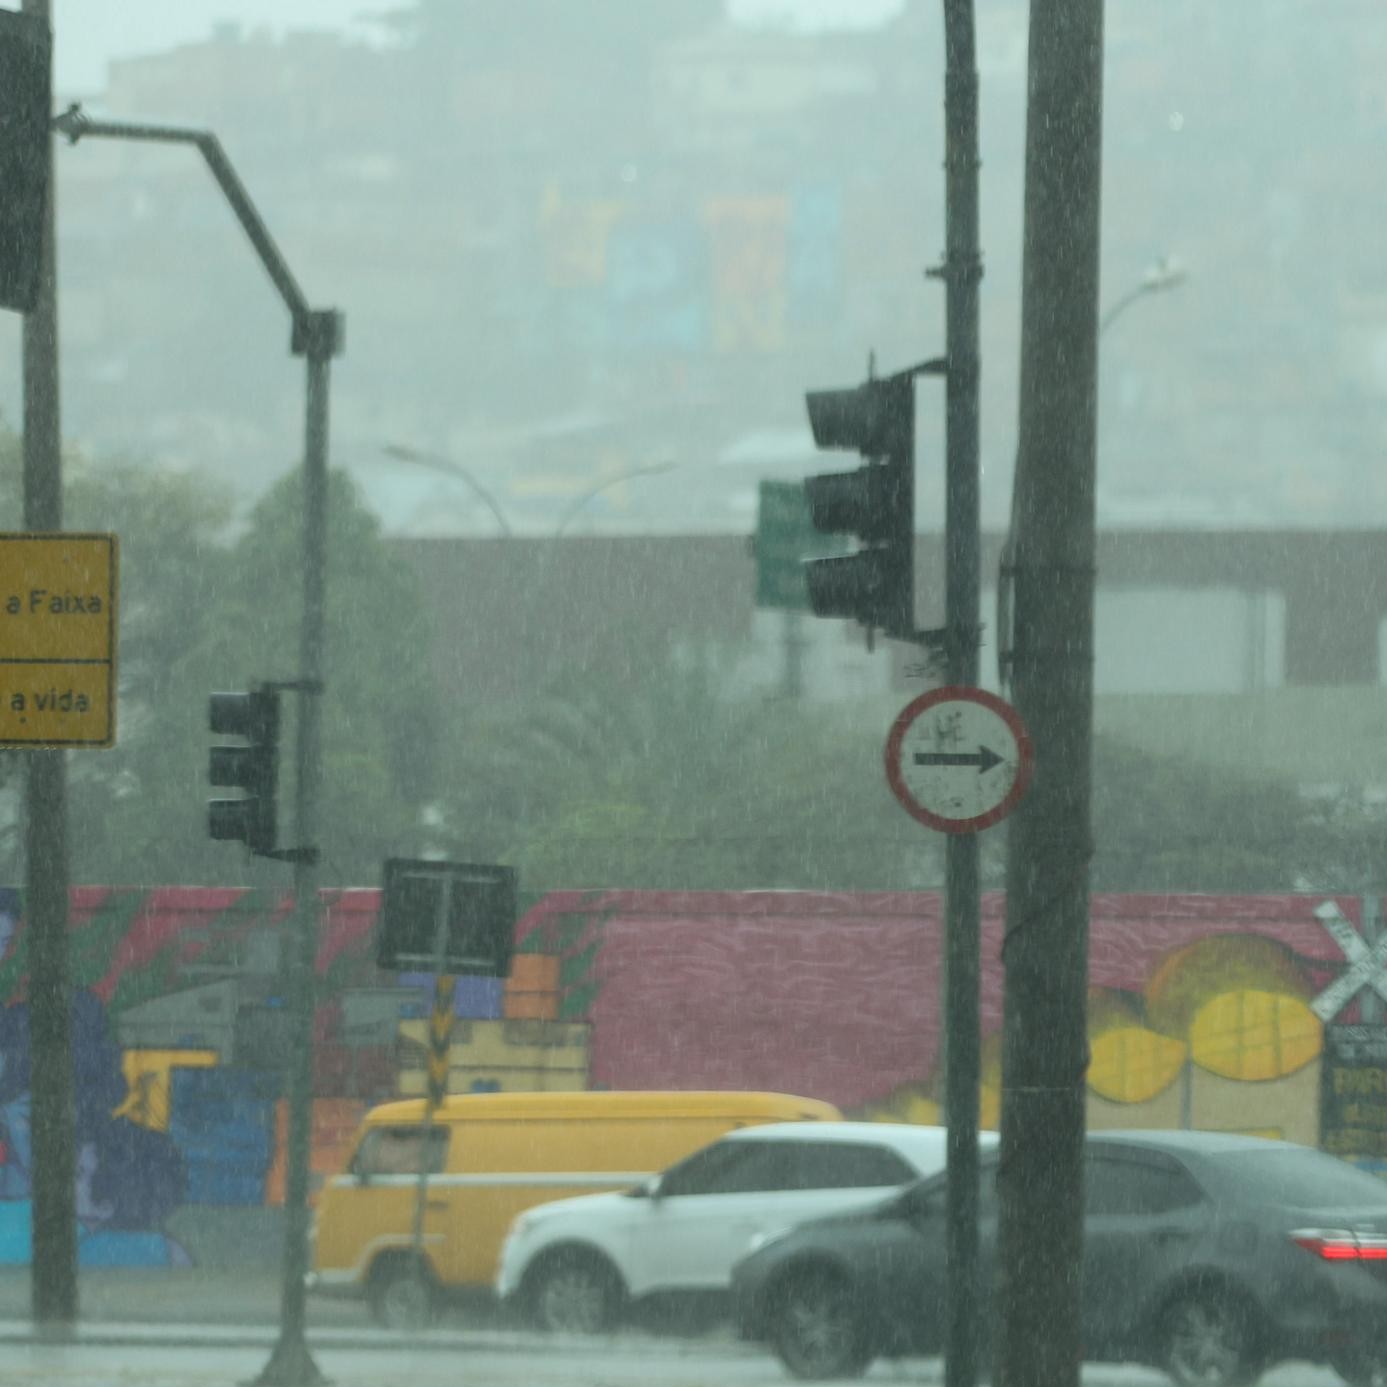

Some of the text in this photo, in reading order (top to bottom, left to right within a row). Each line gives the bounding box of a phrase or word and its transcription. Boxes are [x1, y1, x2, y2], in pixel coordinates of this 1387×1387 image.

[6, 589, 102, 615] a Faixa
[11, 688, 90, 712] a vida
